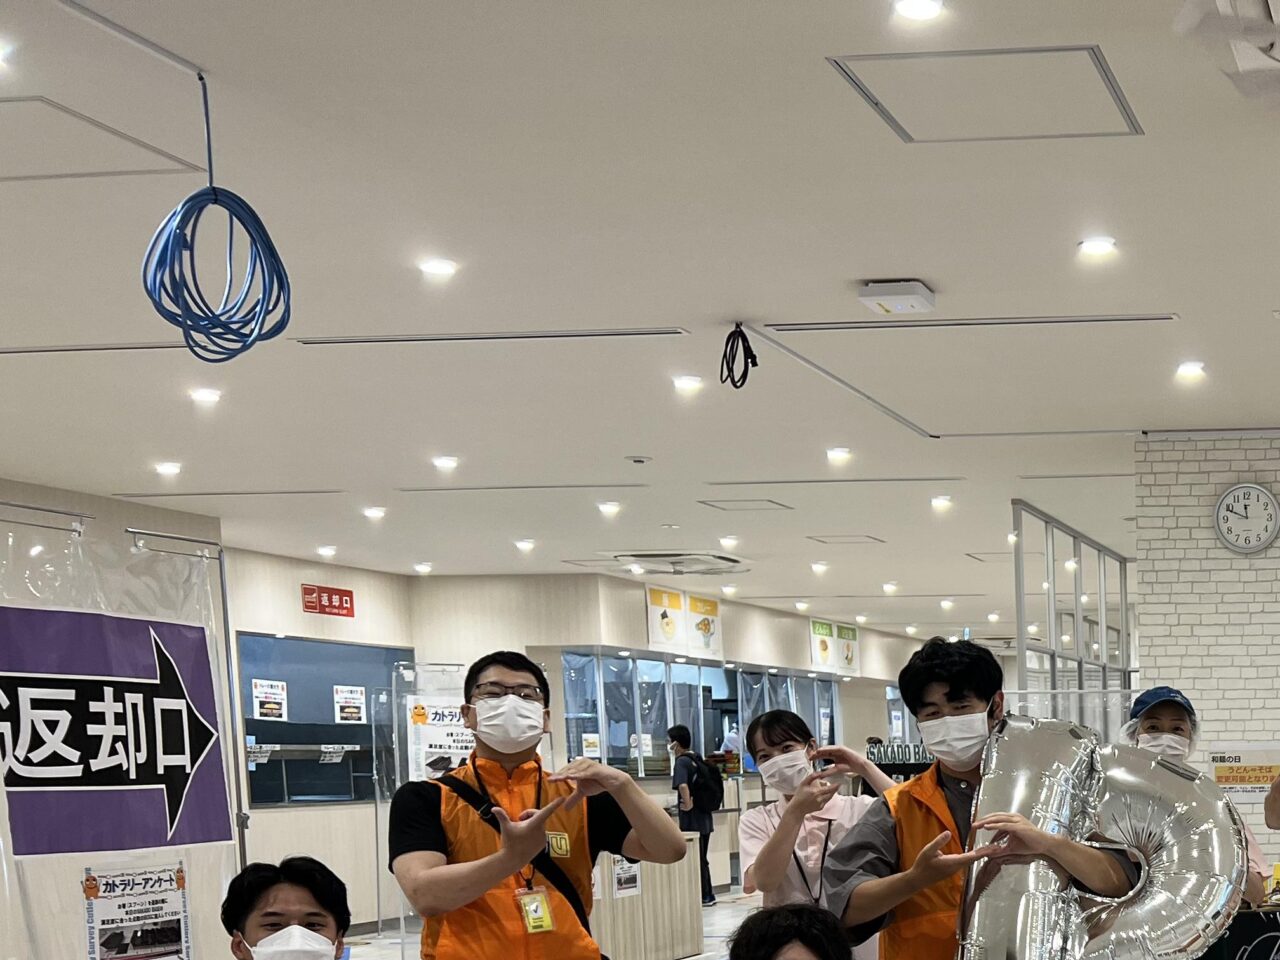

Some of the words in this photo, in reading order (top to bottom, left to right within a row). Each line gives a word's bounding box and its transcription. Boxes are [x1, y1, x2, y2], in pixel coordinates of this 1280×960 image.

[1233, 495, 1240, 503] 11
[1243, 491, 1251, 500] 12
[1256, 494, 1260, 502] 1
[1226, 503, 1234, 512] 10
[1263, 502, 1269, 511] 2
[1222, 515, 1229, 523] 9
[1267, 513, 1273, 522] 3
[1226, 526, 1233, 534] 8
[1263, 525, 1268, 533] 4
[1235, 534, 1240, 542] 7
[1244, 536, 1251, 545] 6
[1256, 534, 1261, 542] 5
[320, 593, 350, 608] 返却口
[431, 710, 461, 722] カトラリ
[0, 686, 192, 780] 返却口
[868, 744, 911, 763] SAKADO
[1211, 755, 1241, 764] 和麺の日
[102, 873, 175, 893] カトラリーアンケート
